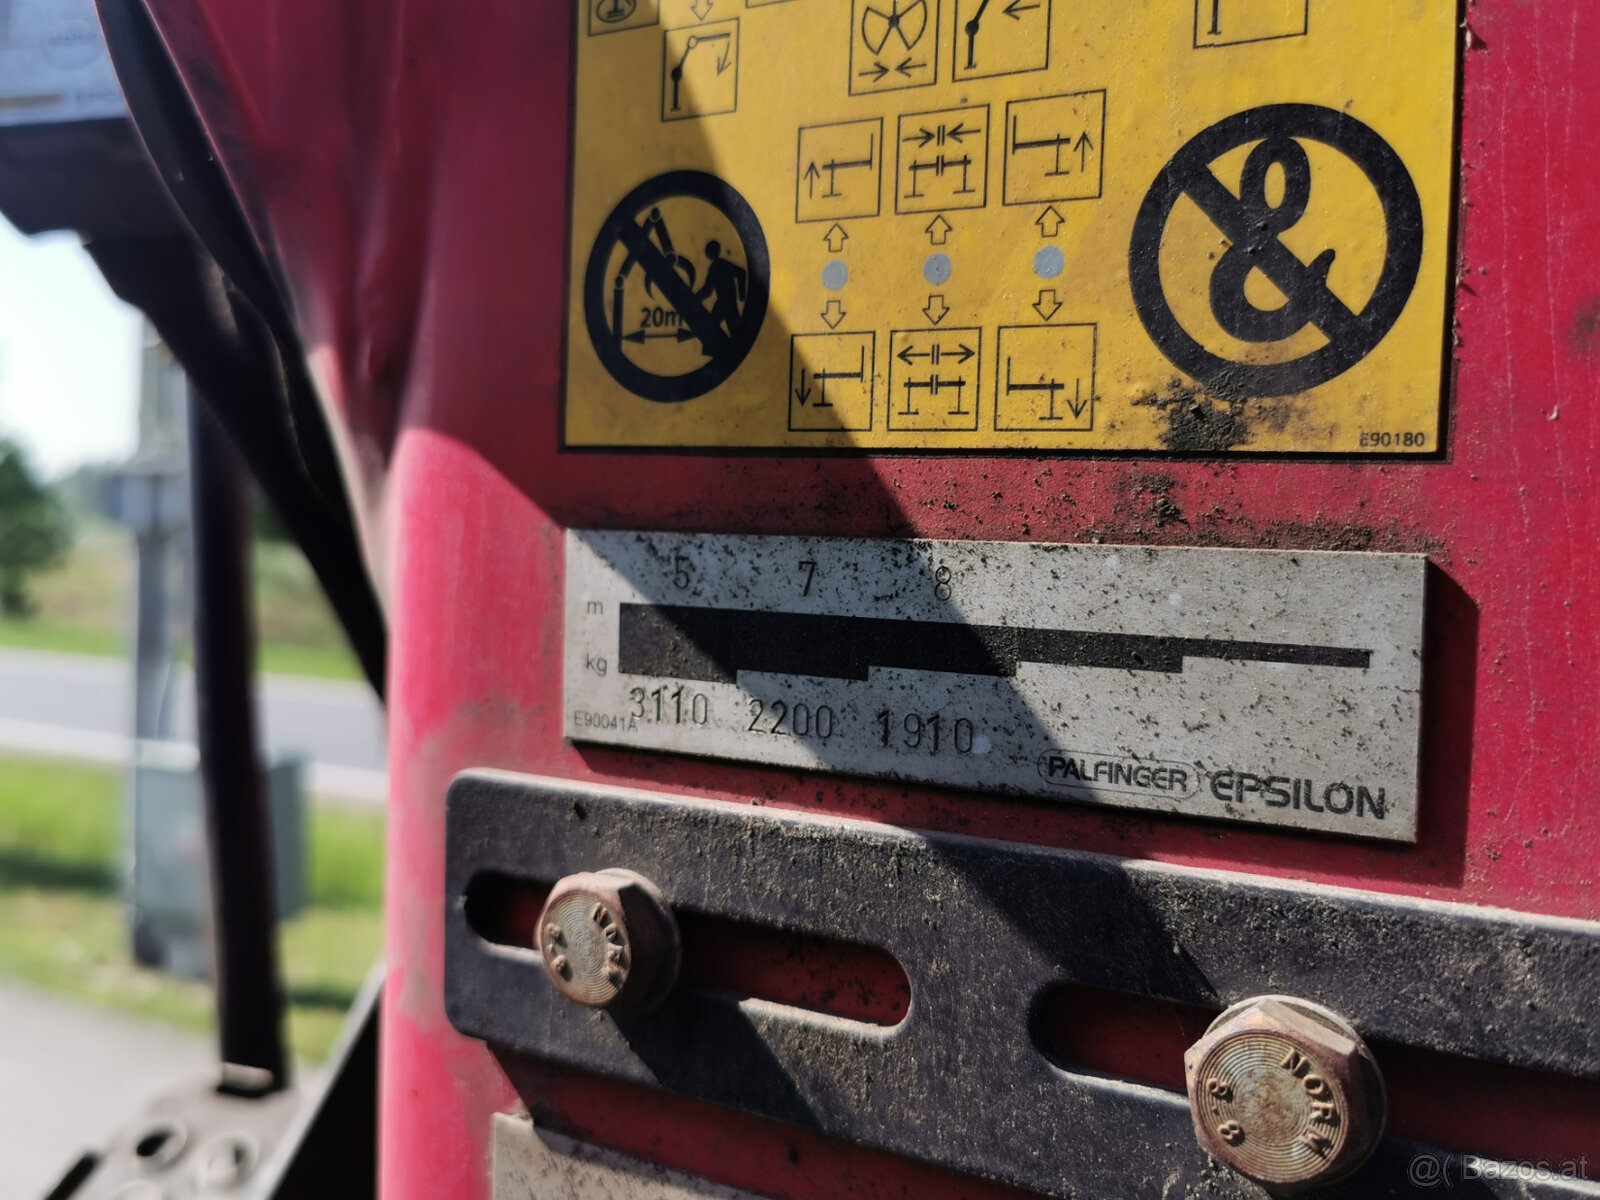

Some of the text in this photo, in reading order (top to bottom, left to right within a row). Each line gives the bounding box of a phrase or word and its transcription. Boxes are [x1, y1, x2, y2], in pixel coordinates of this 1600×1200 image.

[640, 305, 684, 328] 20m
[1359, 431, 1426, 448] E90180
[672, 551, 952, 601] 5 7 8
[586, 600, 605, 616] m
[584, 653, 609, 677] kg
[573, 710, 639, 732] E90041A
[629, 684, 974, 755] 3110 2200 1910
[1046, 754, 1388, 821] PALFINGER EPSILON
